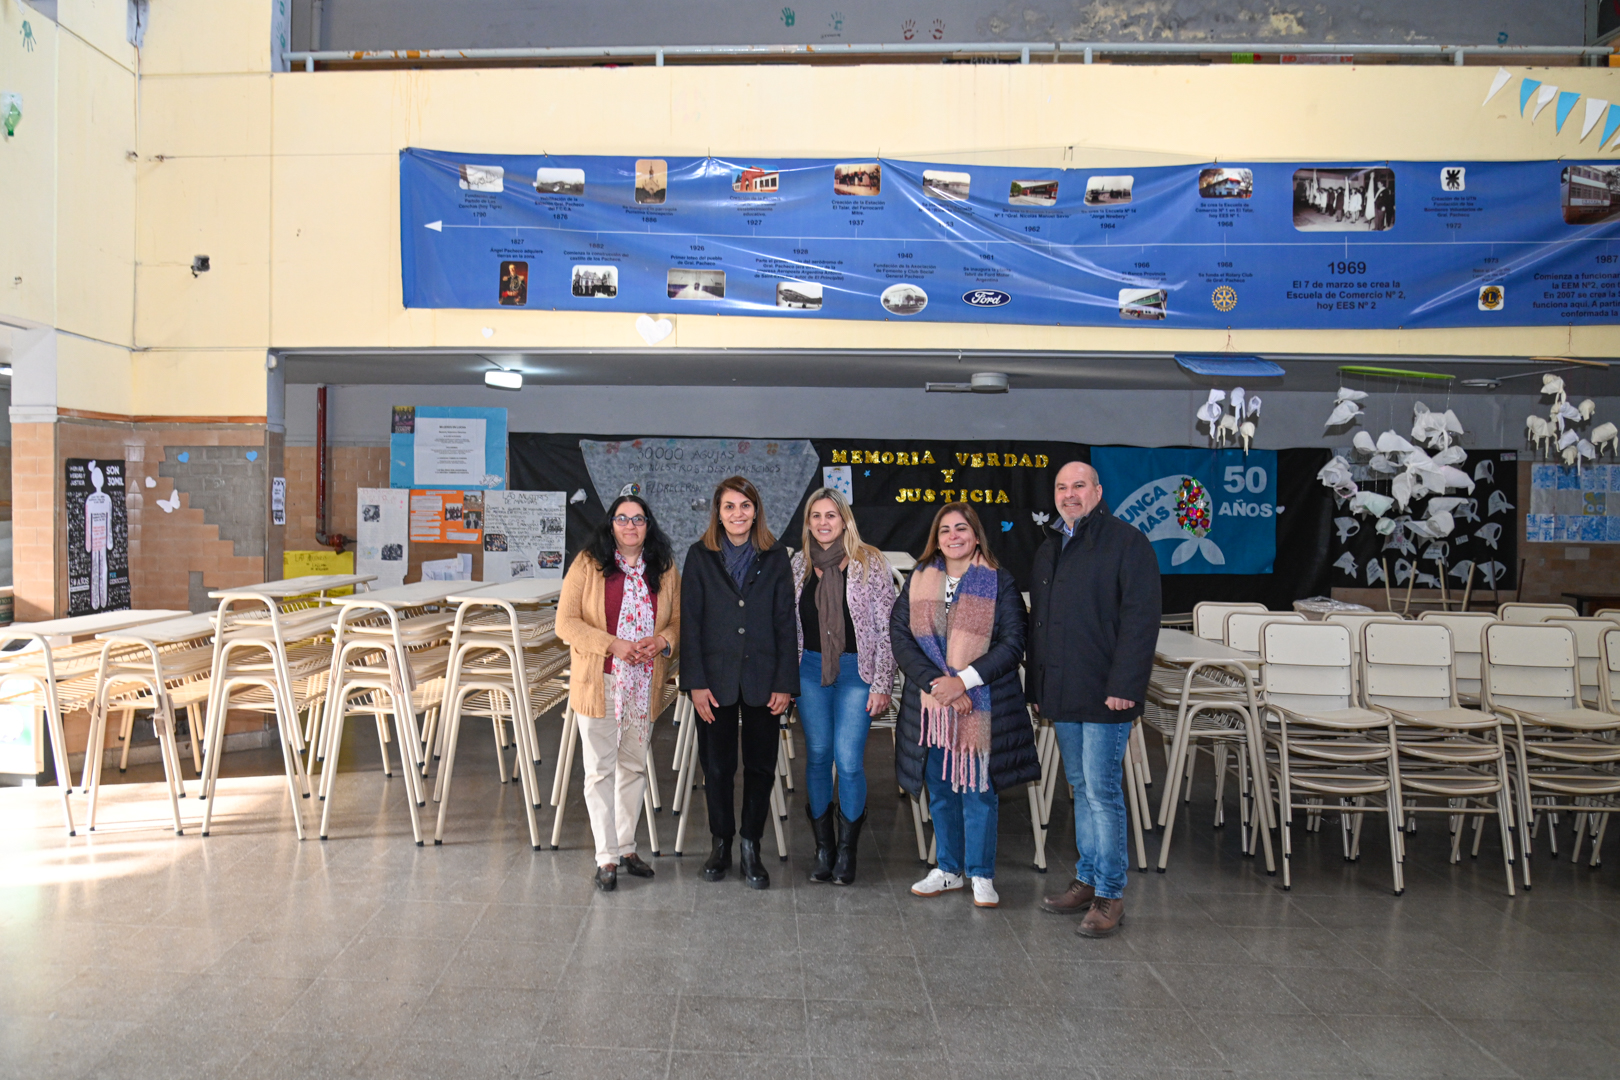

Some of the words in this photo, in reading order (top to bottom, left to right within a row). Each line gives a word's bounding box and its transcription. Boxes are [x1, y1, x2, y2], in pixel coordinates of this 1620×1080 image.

[1595, 255, 1618, 264] 1987
[1328, 261, 1366, 275] 1969
[1533, 272, 1572, 280] Comienza
[1292, 280, 1302, 288] El
[1304, 280, 1310, 288] 7
[1312, 280, 1324, 288] de
[1392, 280, 1400, 288] la
[971, 291, 1002, 305] Ford
[1286, 290, 1323, 299] Escuela
[1325, 290, 1337, 299] de
[1339, 290, 1383, 299] Comercio
[1544, 291, 1554, 299] En
[1557, 291, 1576, 299] 2007
[1608, 290, 1616, 298] la
[1316, 301, 1334, 311] hoy
[1336, 301, 1356, 310] EES
[1370, 301, 1376, 309] 2
[1591, 300, 1598, 308] A
[1560, 310, 1609, 318] conformada
[691, 450, 735, 464] AGUJAS
[831, 449, 936, 466] MEMORIA
[955, 452, 1049, 468] VERDAD
[106, 465, 120, 475] SON
[629, 462, 644, 472] POR
[649, 462, 700, 474] NUESTROS
[940, 469, 956, 483] Y
[1223, 466, 1267, 494] 50
[895, 488, 1010, 503] JUSTICIA
[1118, 486, 1168, 524] UNCA
[1218, 499, 1273, 517] AÑOS
